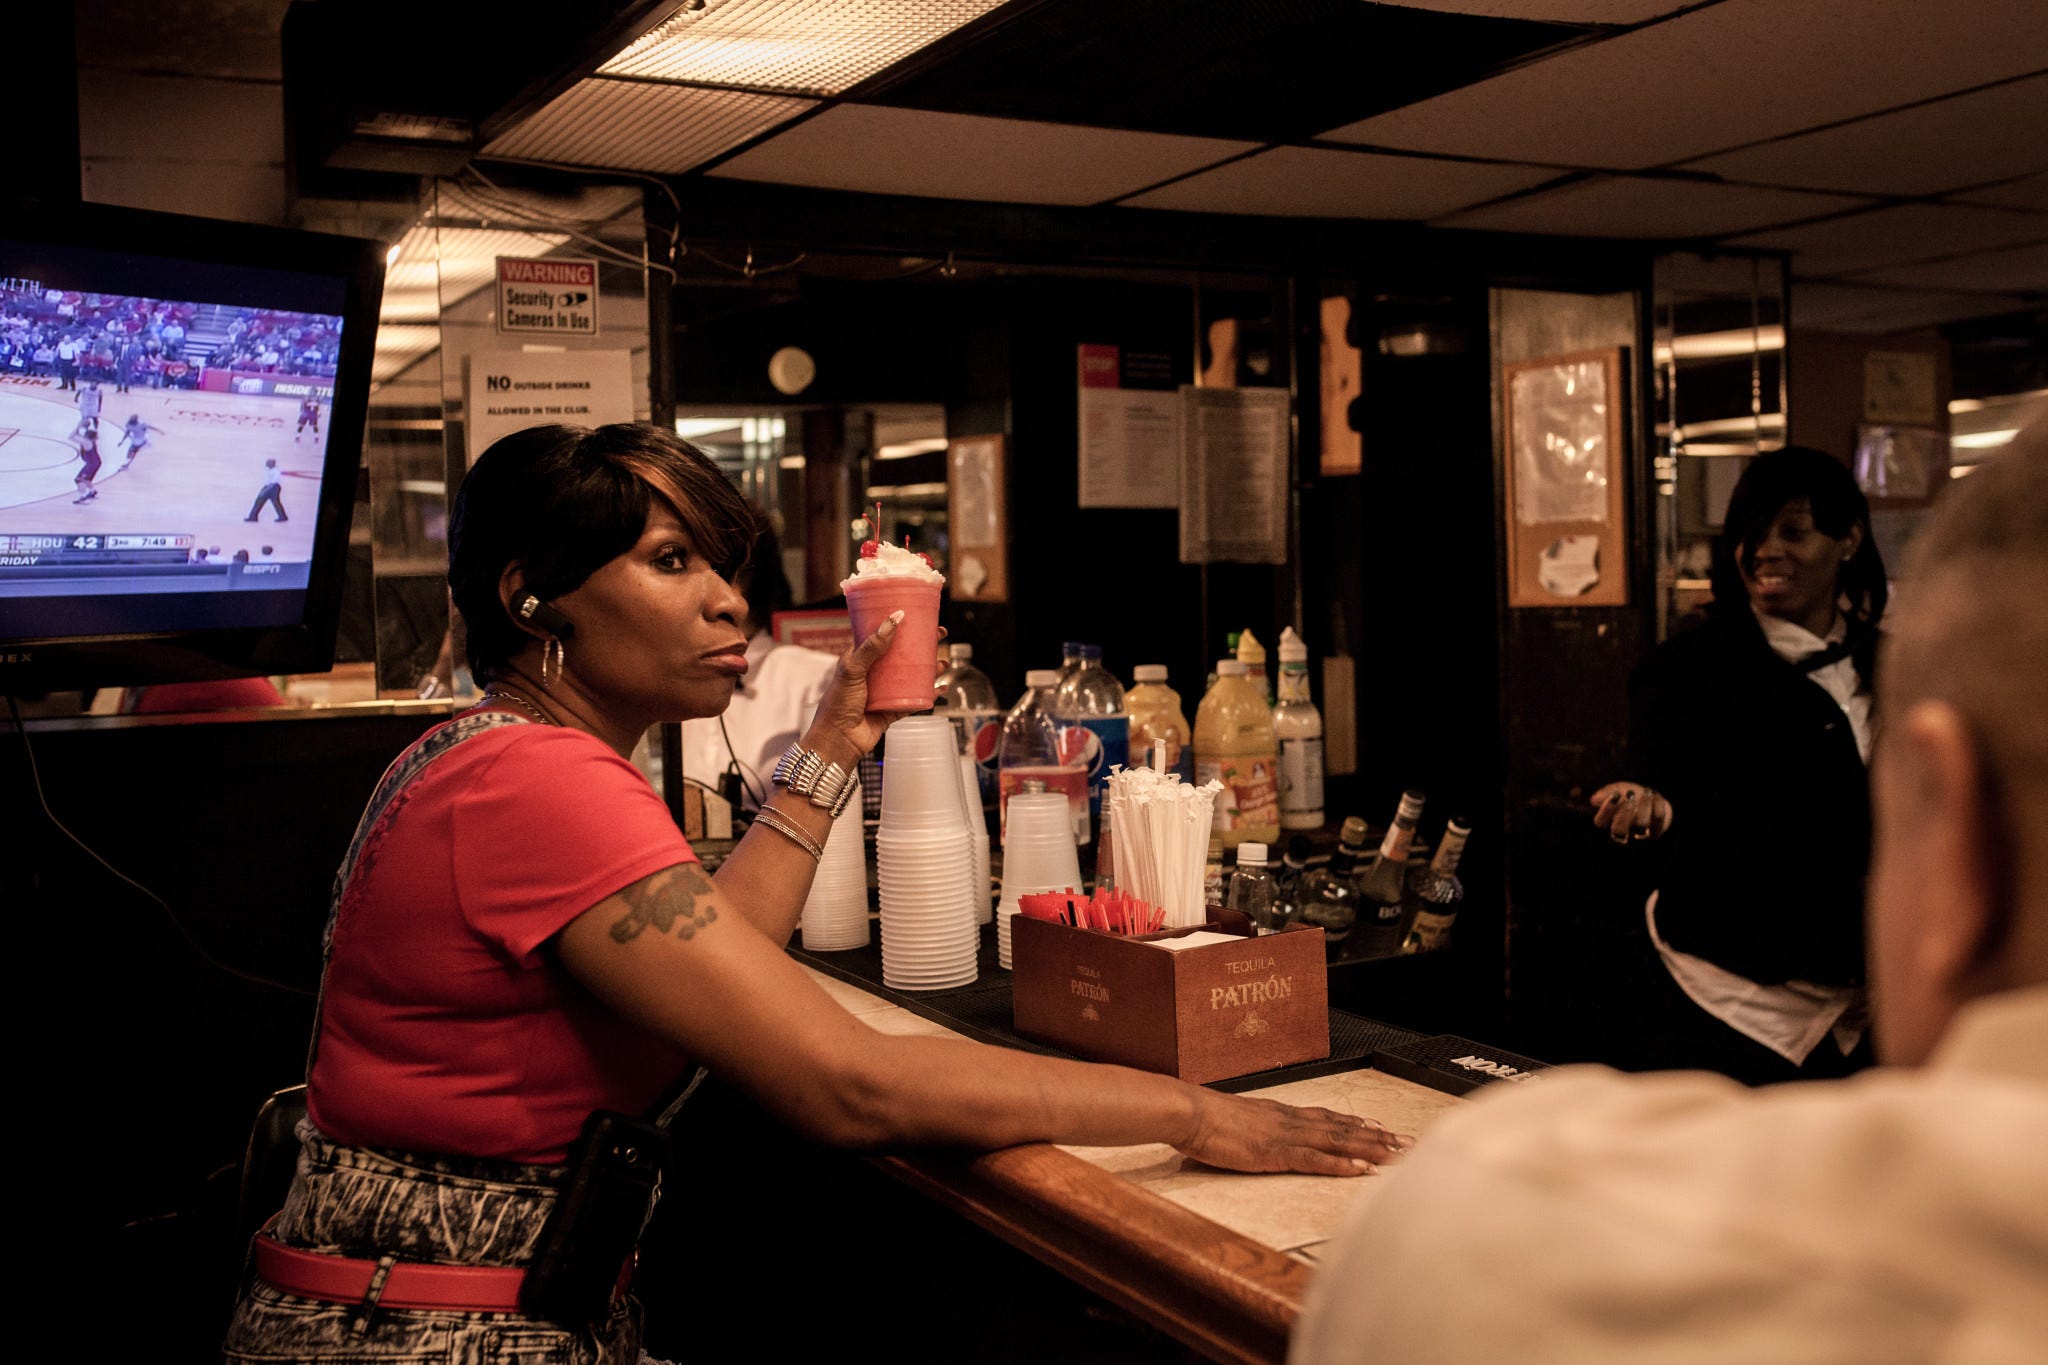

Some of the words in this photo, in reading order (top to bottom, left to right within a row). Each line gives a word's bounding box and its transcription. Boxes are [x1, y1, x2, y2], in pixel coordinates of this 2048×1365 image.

[504, 261, 591, 284] WARNING
[507, 288, 553, 310] Security
[507, 309, 553, 327] Cameras
[557, 312, 568, 327] In
[571, 312, 588, 328] Use
[487, 376, 511, 390] NO
[514, 382, 552, 390] OUTSIDE
[487, 407, 530, 415] ALLOWED
[32, 536, 63, 548] HOU
[73, 536, 98, 549] 42
[1224, 957, 1276, 974] TEQUILA
[1210, 974, 1292, 1010] PATRÓN
